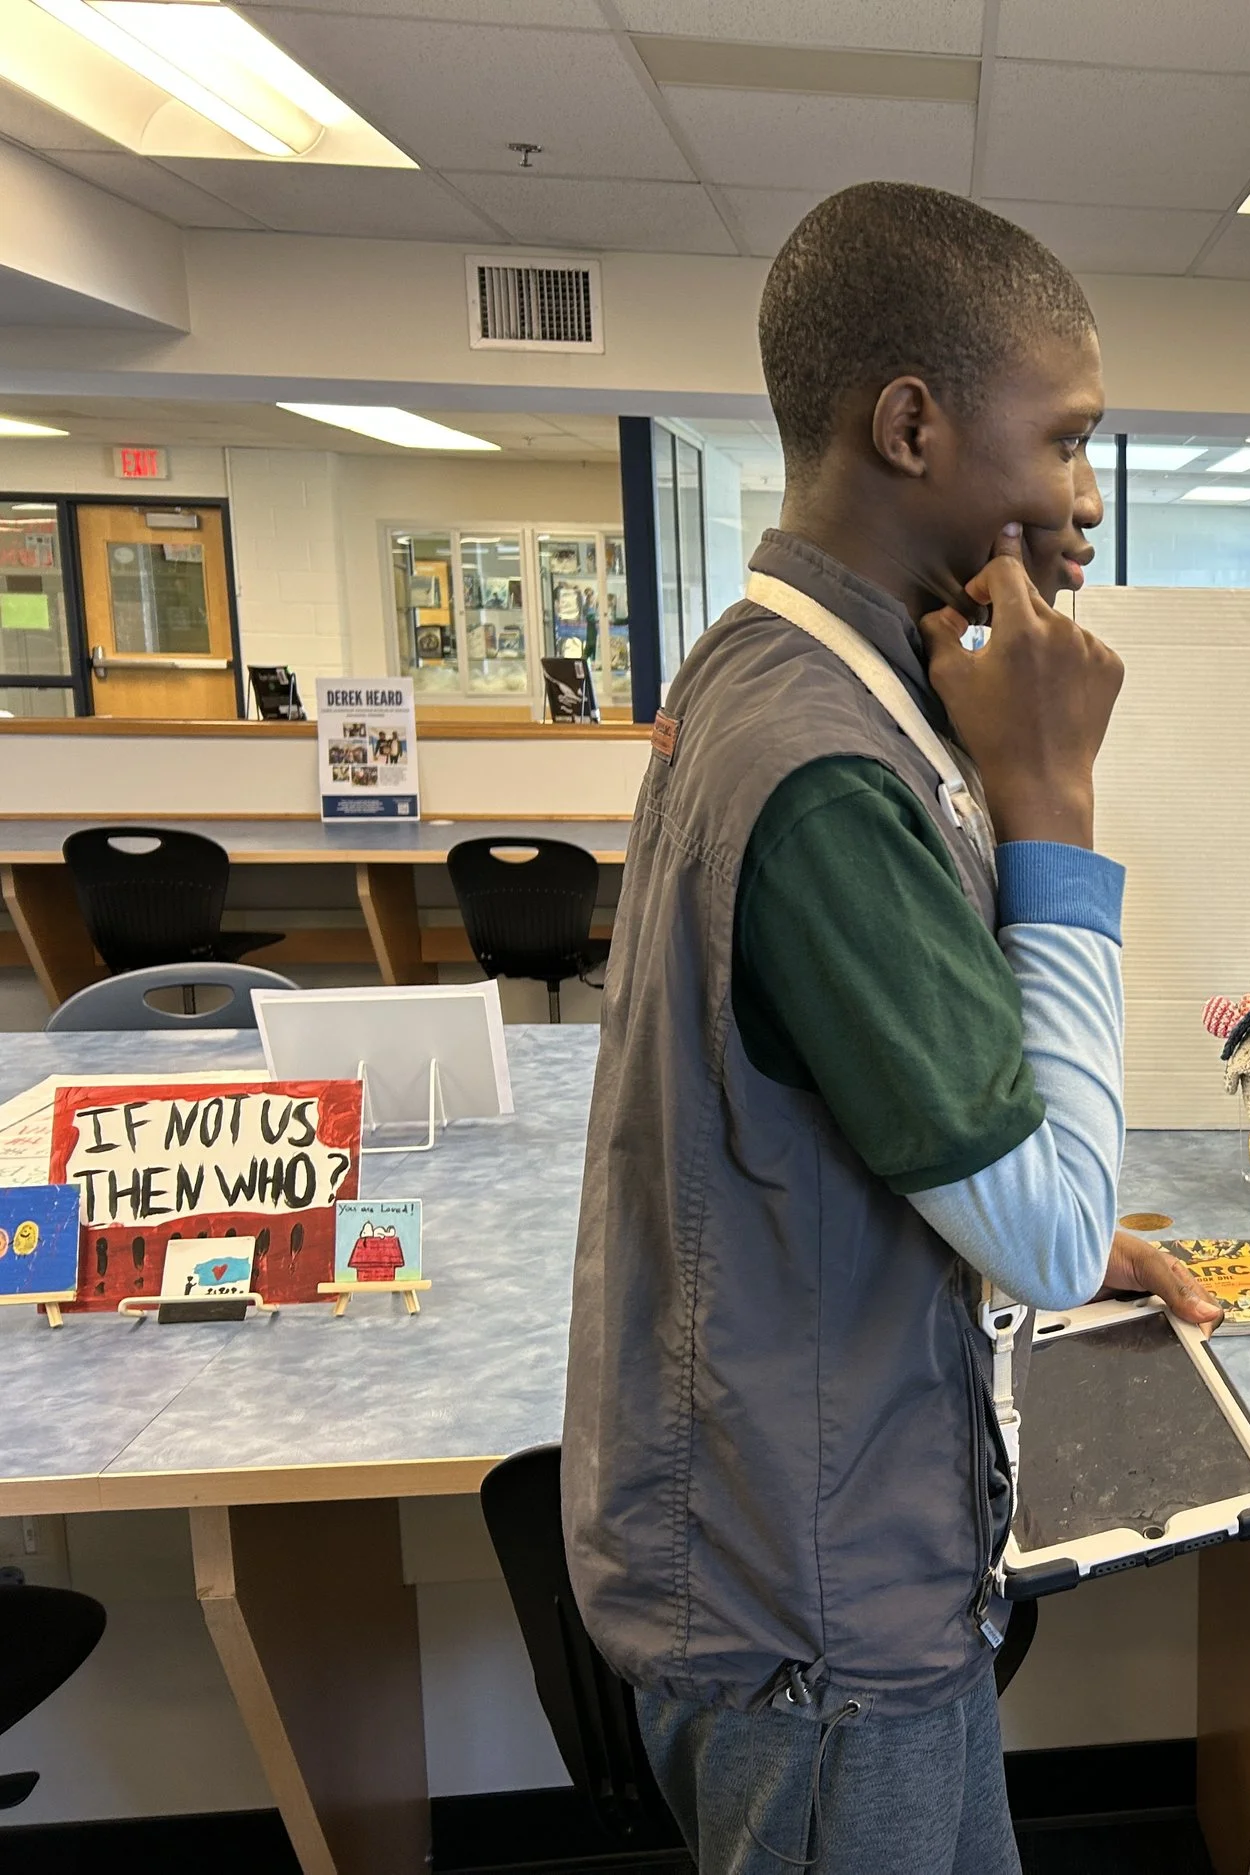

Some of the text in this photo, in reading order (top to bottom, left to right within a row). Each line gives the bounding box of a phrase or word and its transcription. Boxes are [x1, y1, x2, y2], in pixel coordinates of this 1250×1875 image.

[122, 449, 156, 476] EXIT
[327, 690, 403, 706] DEREK HEARD
[76, 1101, 151, 1154] IF
[164, 1093, 251, 1150] NOT
[259, 1098, 318, 1148] US
[72, 1152, 350, 1224] THEN WHO?
[338, 1204, 356, 1216] You
[380, 1203, 414, 1216] Loved!
